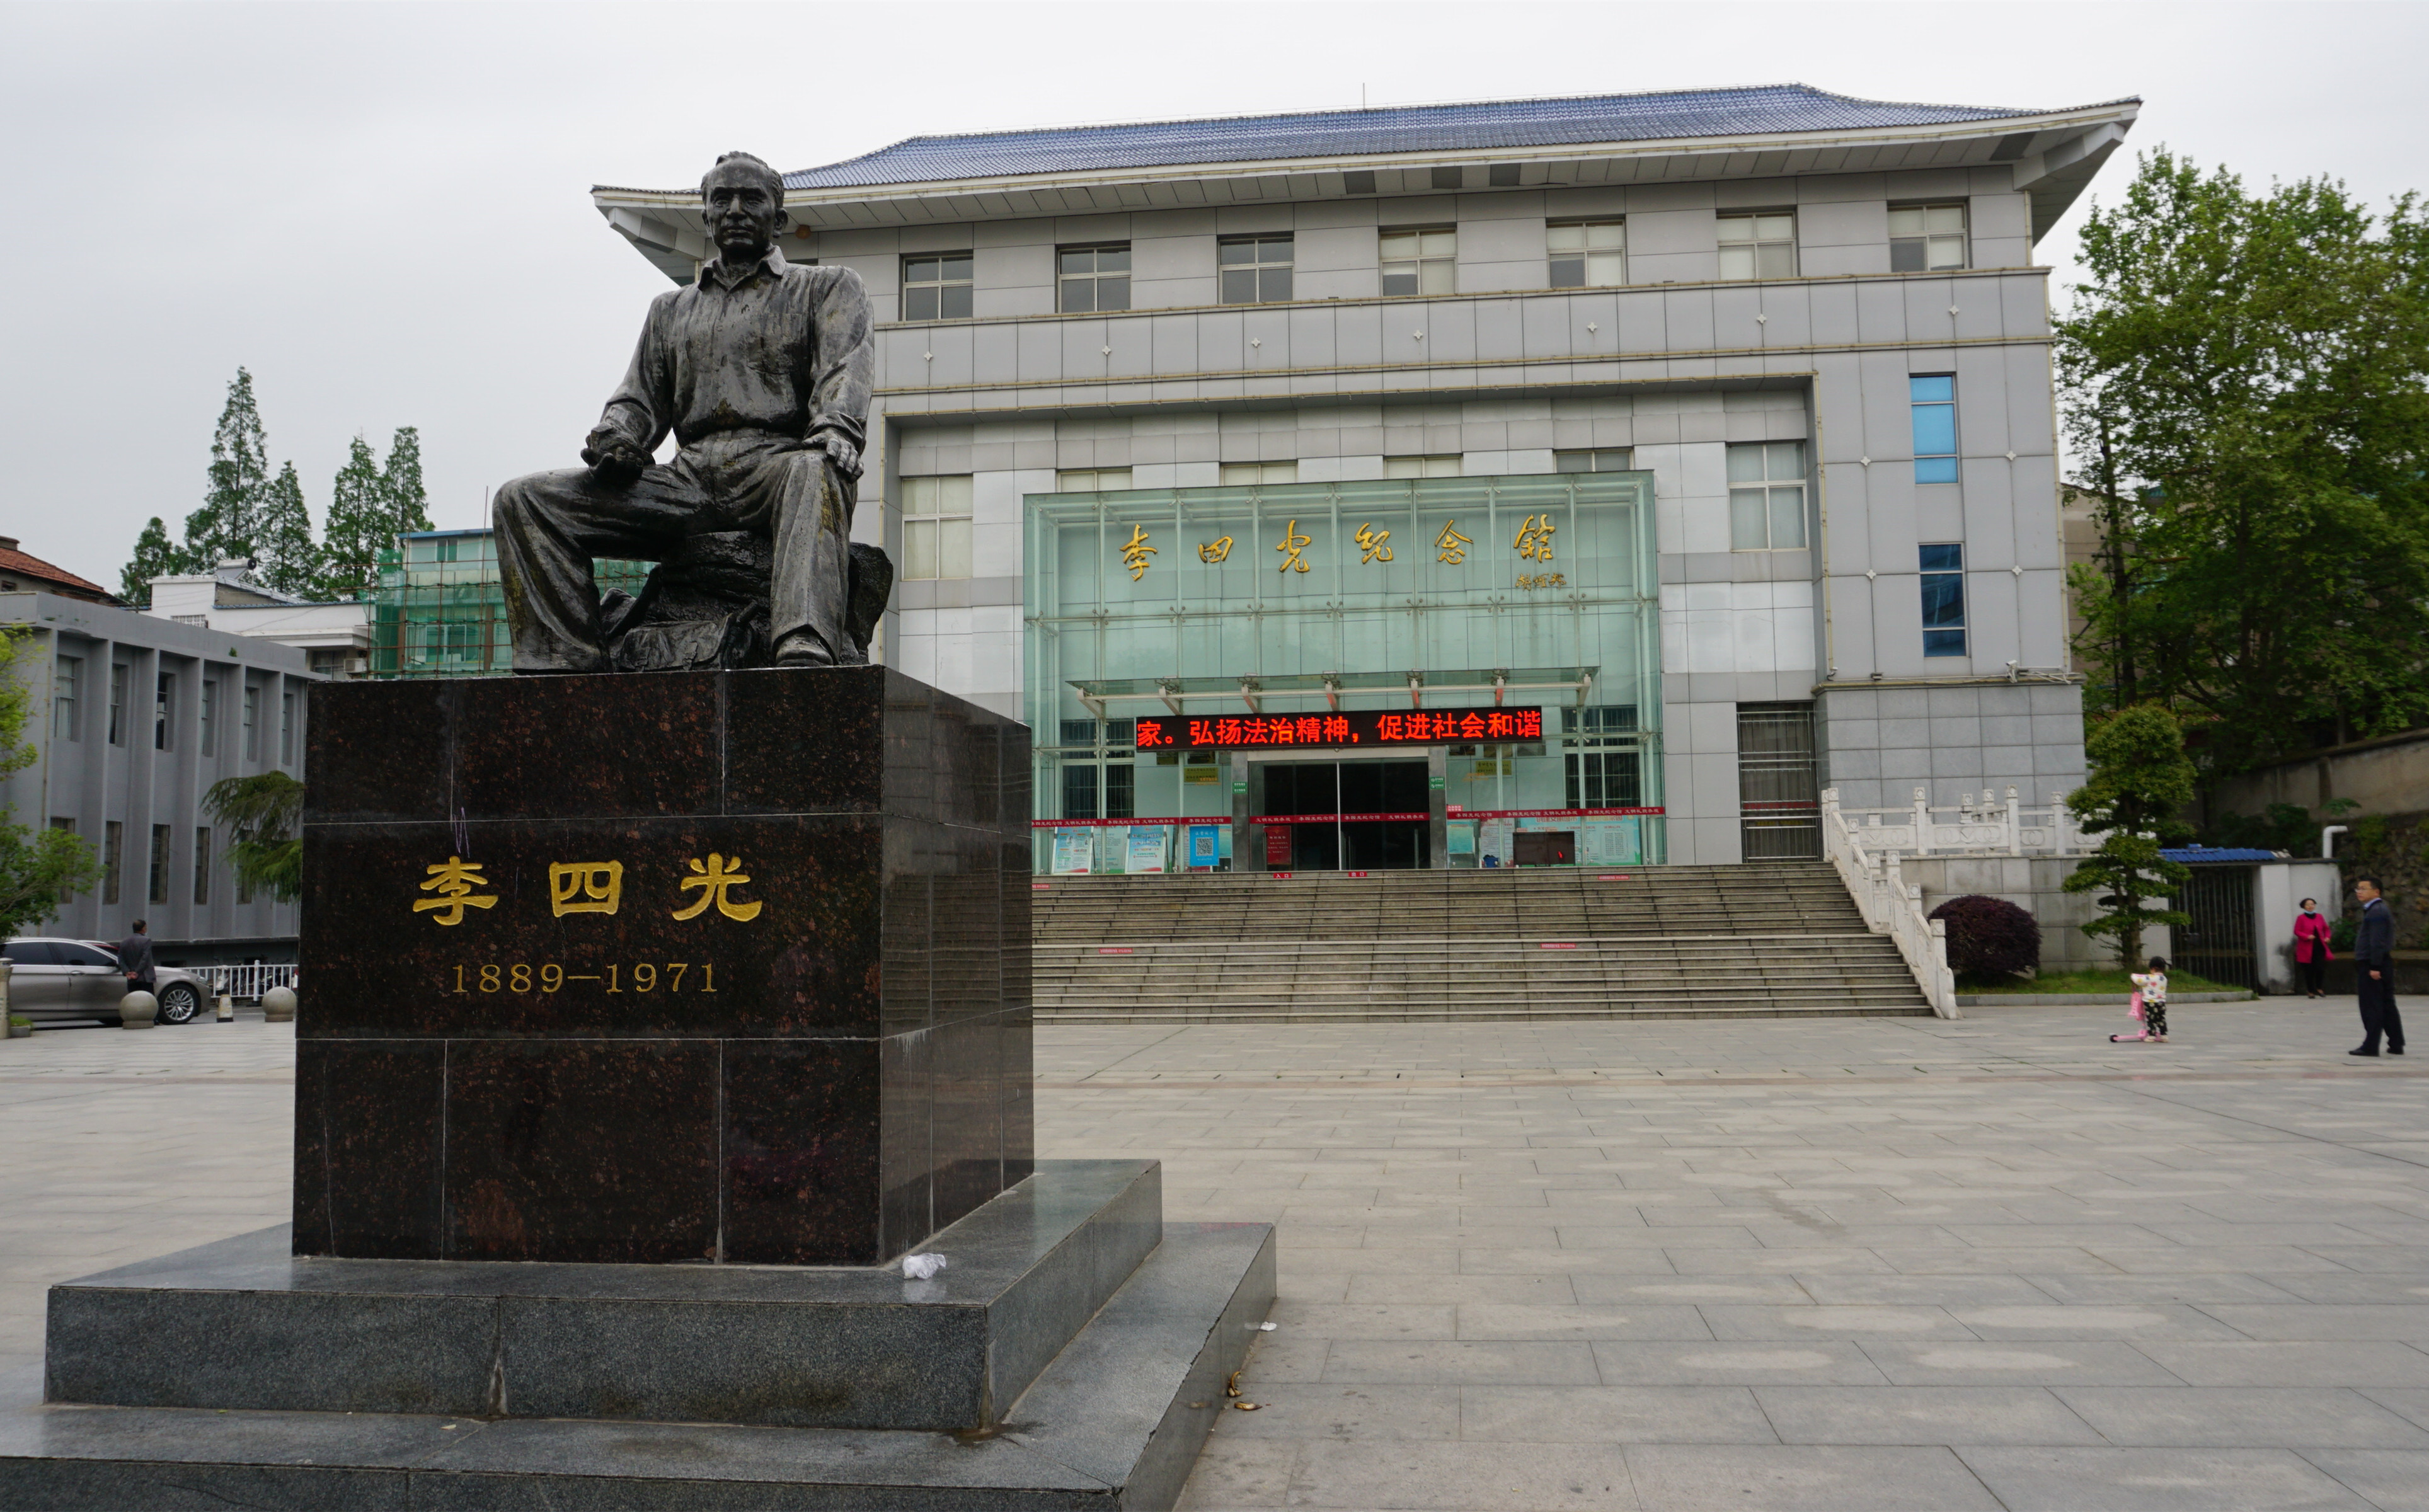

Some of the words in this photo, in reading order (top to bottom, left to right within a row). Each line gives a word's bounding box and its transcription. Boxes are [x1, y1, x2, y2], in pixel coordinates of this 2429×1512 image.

[1119, 513, 1555, 580] 李四光纪念馆
[413, 852, 762, 925] 李四光
